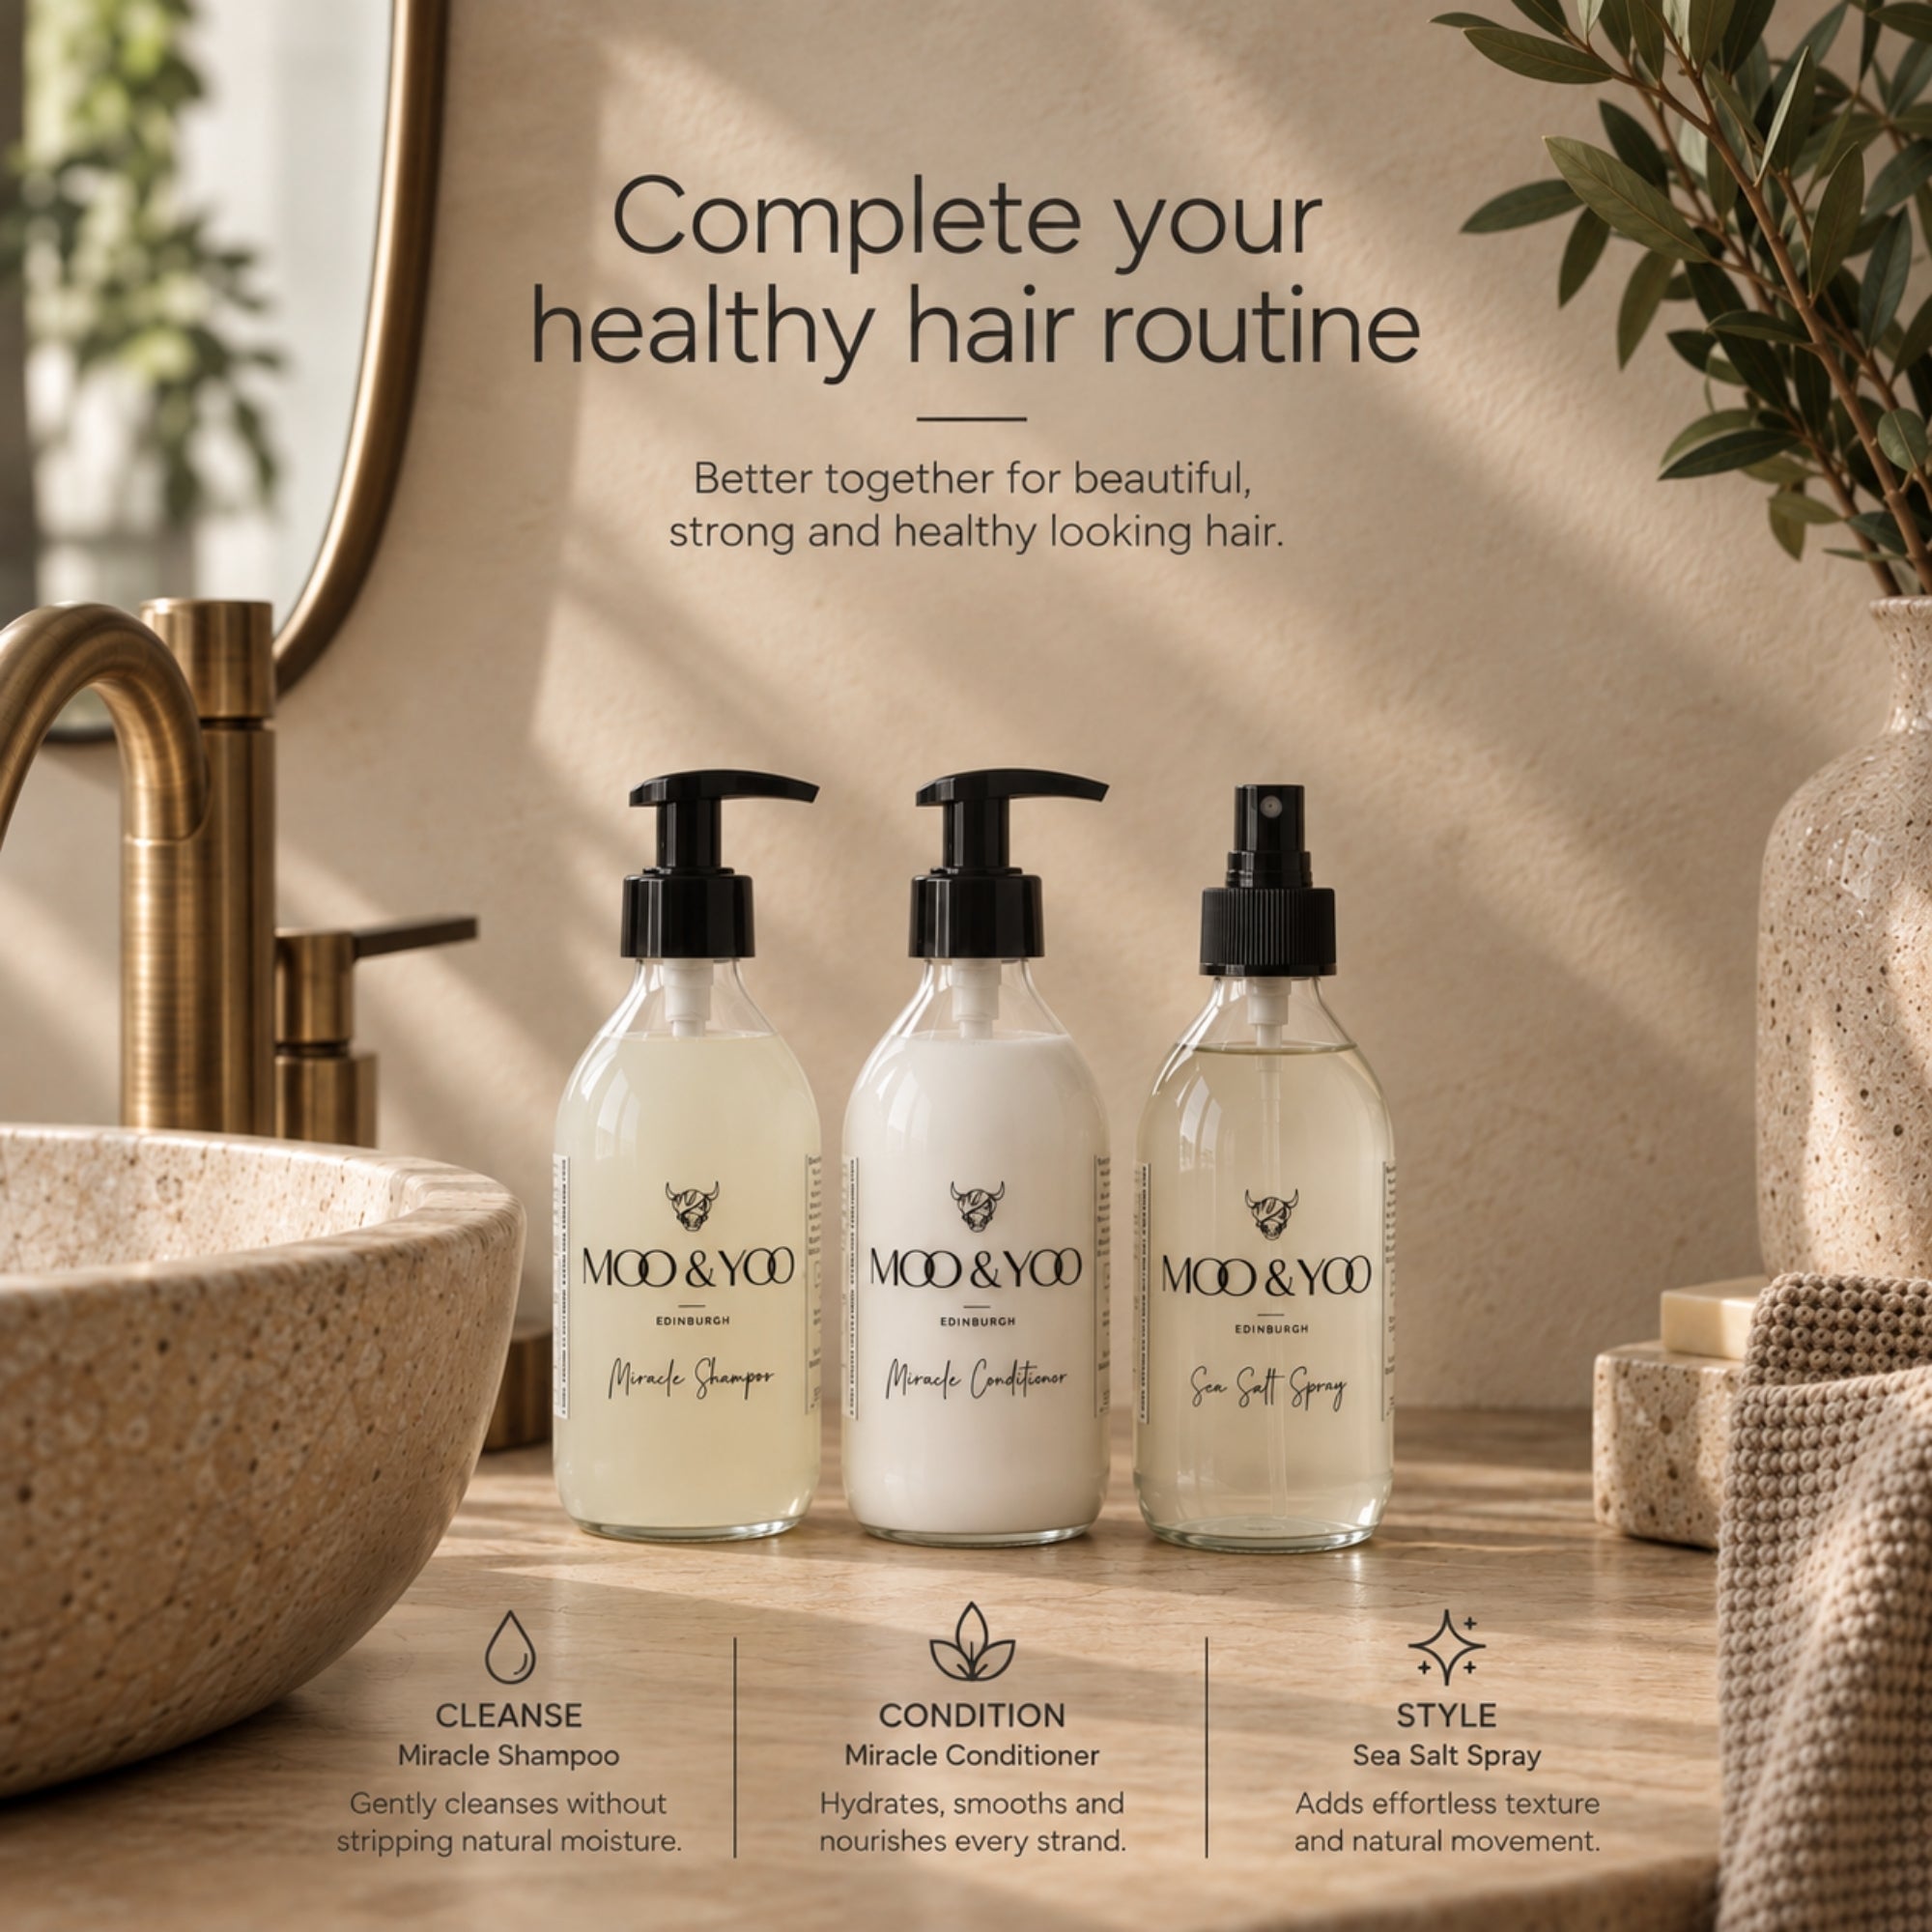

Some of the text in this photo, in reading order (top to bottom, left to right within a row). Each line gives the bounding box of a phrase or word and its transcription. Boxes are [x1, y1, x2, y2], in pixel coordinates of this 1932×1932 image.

[582, 1246, 678, 1289] MOO
[869, 1246, 963, 1290] MOO
[1162, 1254, 1258, 1297] MOO
[655, 1315, 730, 1326] EDINBURGH
[940, 1316, 1016, 1328] EDINBURGH
[1235, 1323, 1309, 1335] EDINBURGH
[608, 1356, 687, 1400] Miracle
[885, 1357, 963, 1401] Miracle
[1190, 1364, 1349, 1413] Sea Salt Spray
